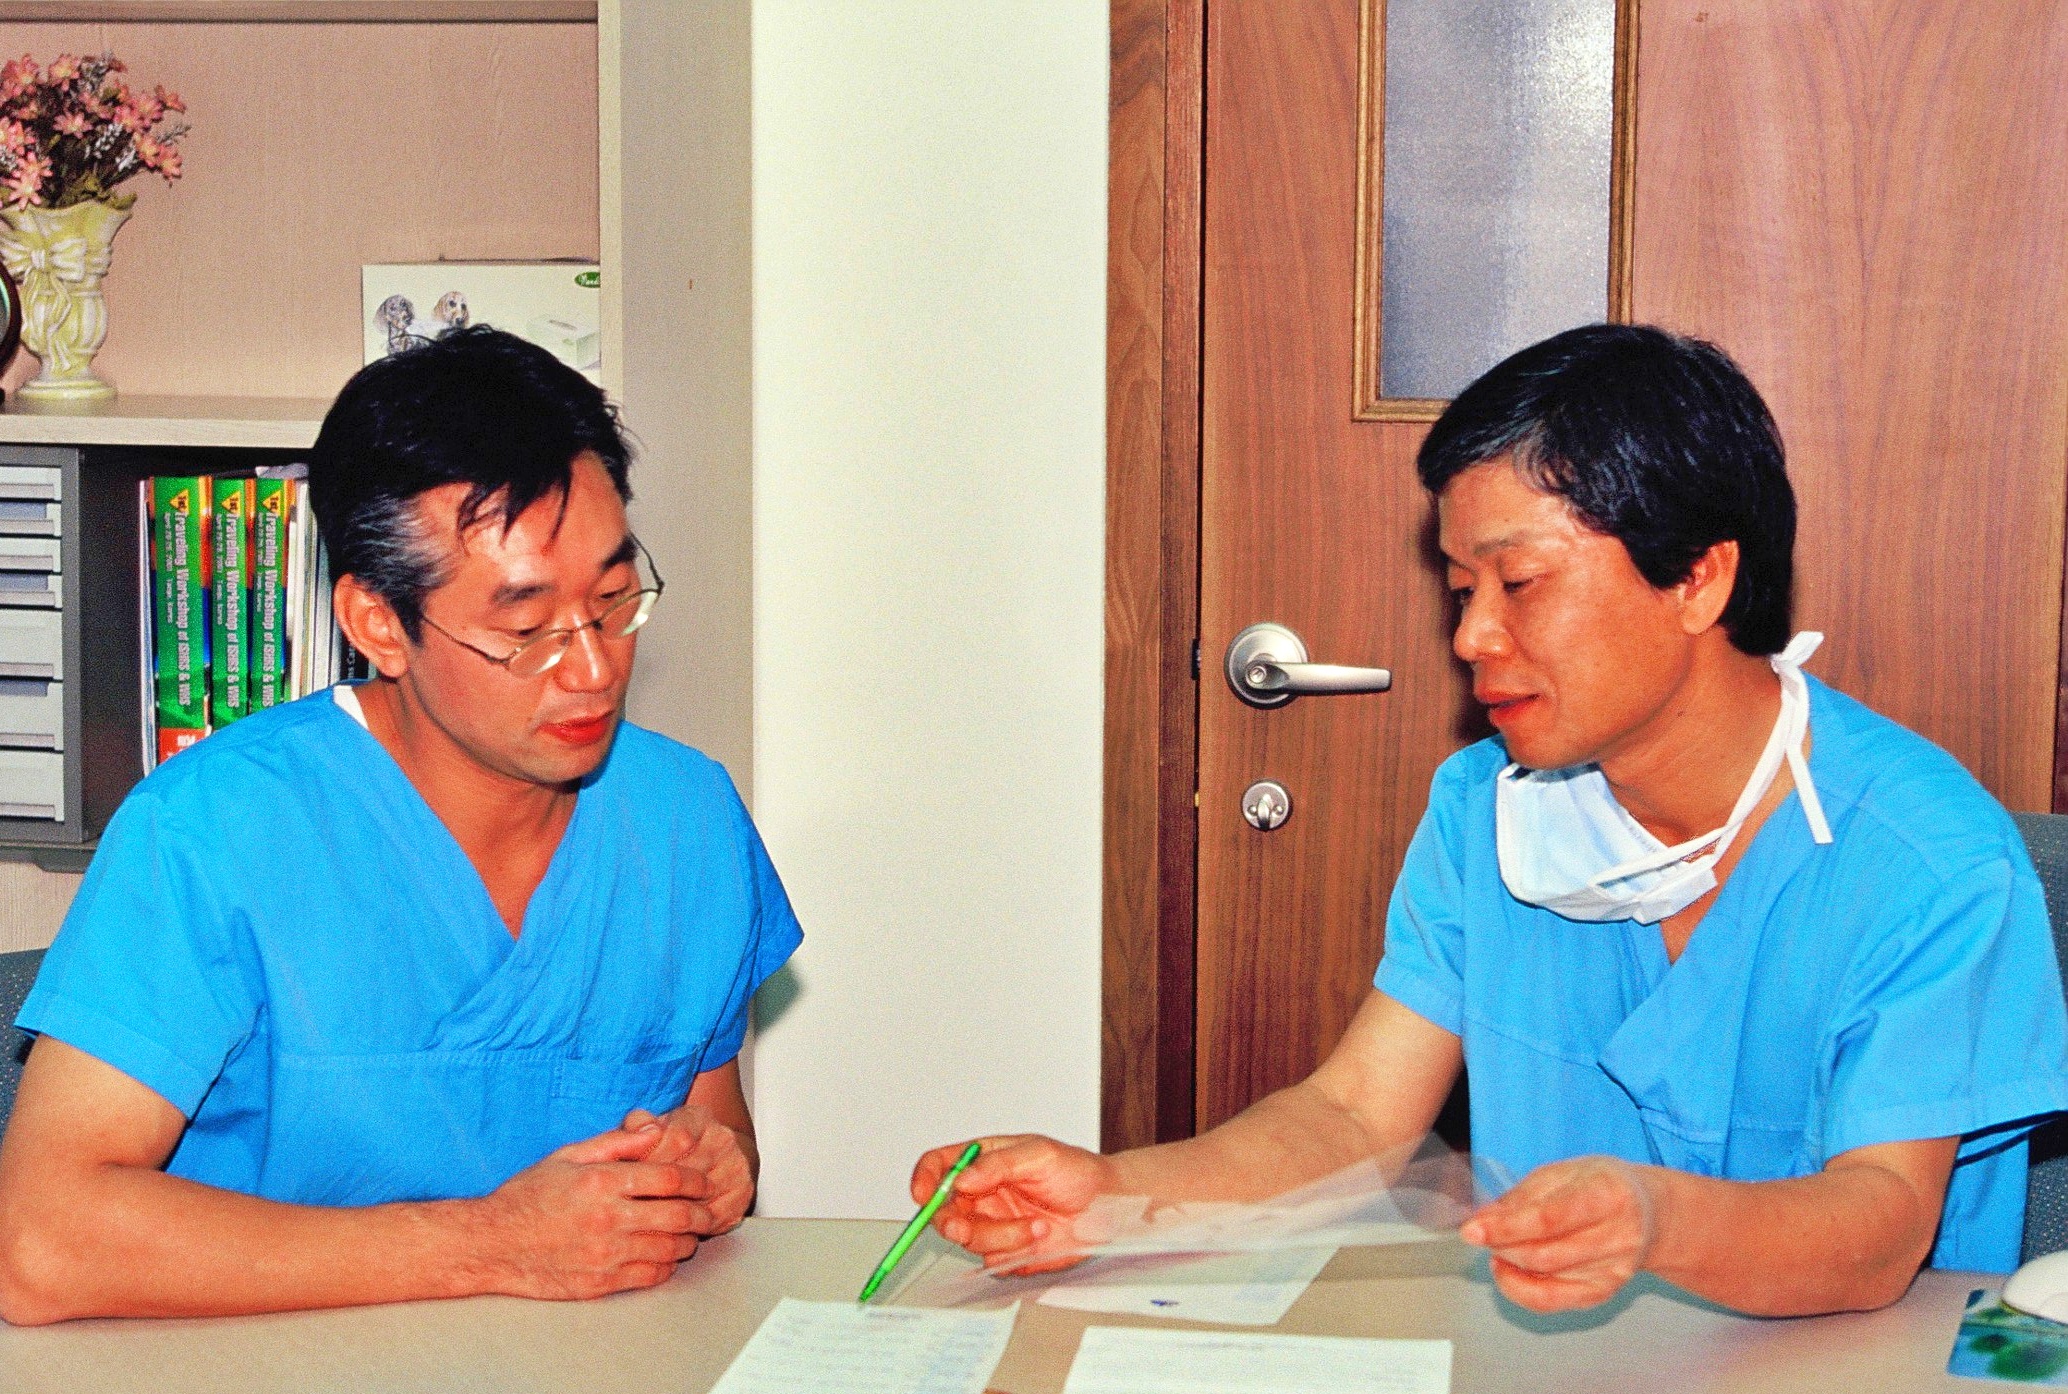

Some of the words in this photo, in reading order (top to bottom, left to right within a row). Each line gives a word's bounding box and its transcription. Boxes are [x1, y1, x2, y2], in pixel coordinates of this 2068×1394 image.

[174, 511, 188, 566] Traveling
[225, 513, 240, 567] Traveling
[263, 512, 279, 567] Traveling
[175, 568, 190, 629] Workshop
[225, 569, 240, 630] Workshop
[262, 569, 278, 630] Workshop
[178, 631, 189, 641] of
[227, 632, 239, 643] of
[264, 632, 275, 642] of
[178, 673, 190, 681] &
[227, 674, 240, 683] &
[262, 673, 275, 682] &
